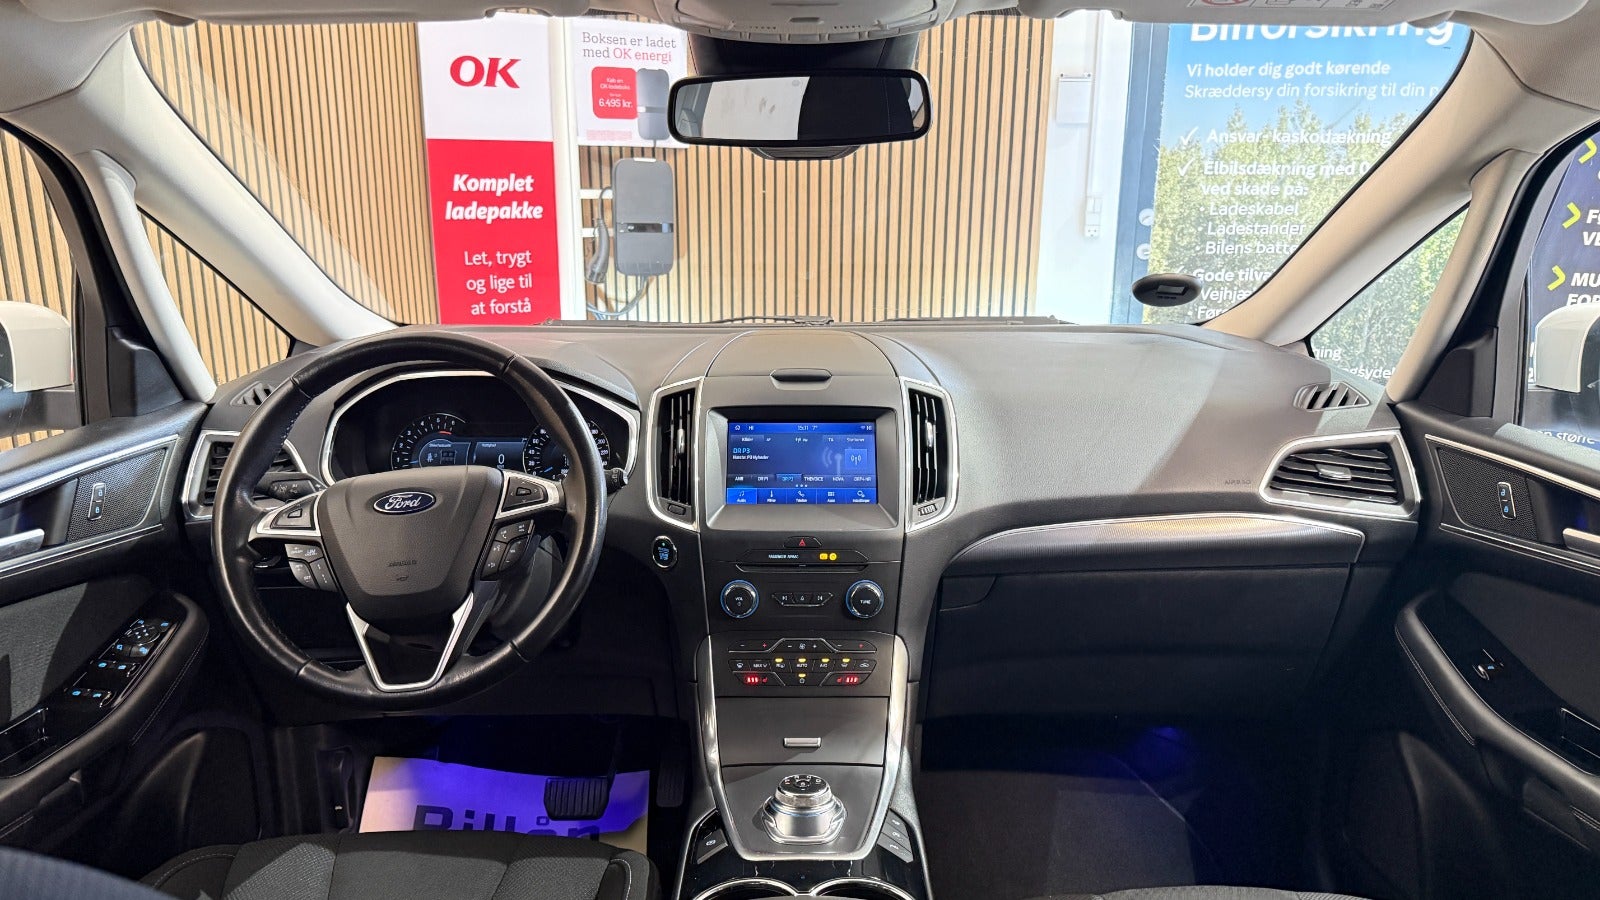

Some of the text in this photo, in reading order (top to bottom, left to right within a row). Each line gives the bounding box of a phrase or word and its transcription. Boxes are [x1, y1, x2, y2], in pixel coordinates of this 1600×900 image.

[582, 31, 677, 48] Boksen er ladet
[583, 47, 672, 64] med OK energi
[450, 55, 521, 89] OK
[1187, 60, 1391, 79] Vi holder dig godt kørende
[1184, 83, 1273, 101] Skræddersy
[1276, 82, 1300, 97] din
[1304, 82, 1378, 100] forsikring
[1381, 83, 1396, 97] til
[1400, 82, 1425, 97] din
[598, 98, 621, 108] 6.495
[1206, 128, 1393, 147] Ansvar- kaskodækning
[1203, 160, 1316, 179] Elbilsdækning
[1319, 161, 1355, 176] med
[453, 173, 534, 197] Komplet
[1201, 181, 1309, 198] ved skade på:
[445, 201, 544, 224] ladepakke
[1209, 201, 1299, 216] Ladeskabel
[1586, 209, 1600, 225] F
[1207, 221, 1306, 236] Ladestander
[1205, 240, 1251, 255] Bilens
[464, 250, 532, 268] Let, trygt
[1192, 267, 1276, 282] Gode tilva
[466, 273, 533, 295] og lige til
[1200, 287, 1256, 303] Vejhjæ
[471, 297, 532, 315] at forstå
[1197, 305, 1230, 320] Før
[498, 453, 505, 465] 0
[384, 494, 422, 510] Ford
